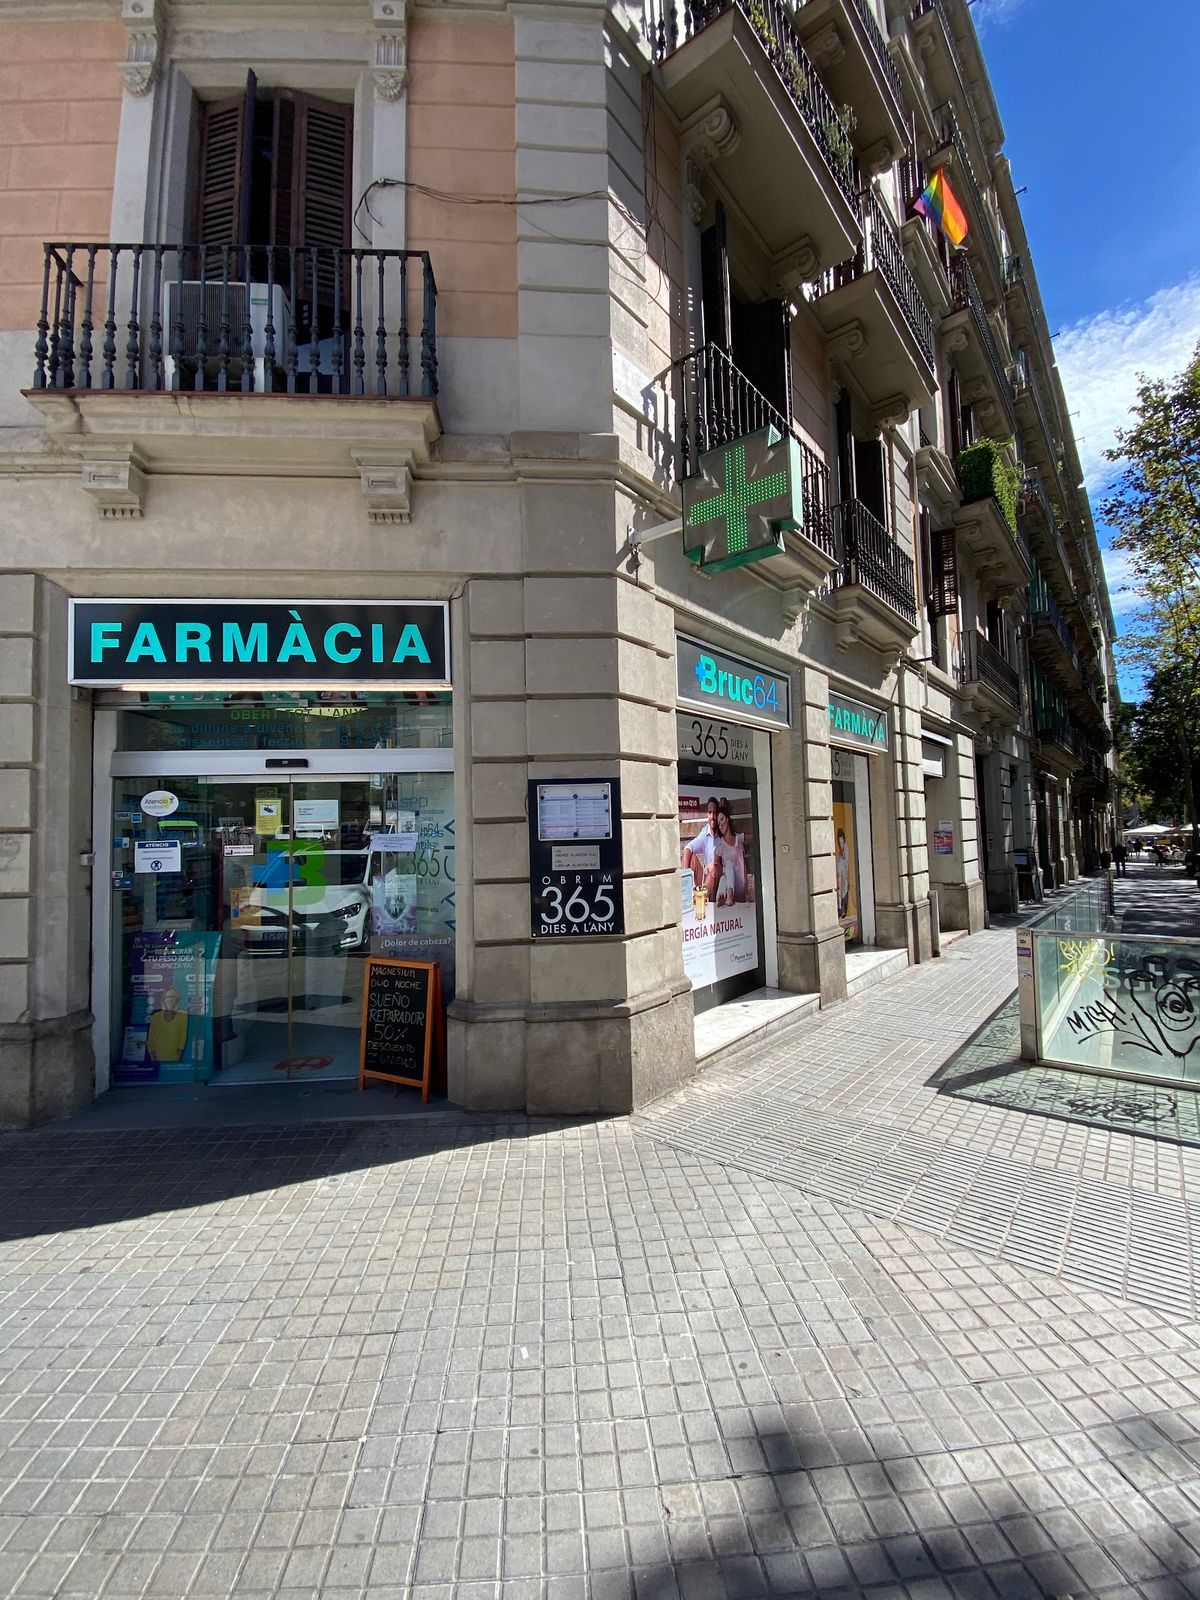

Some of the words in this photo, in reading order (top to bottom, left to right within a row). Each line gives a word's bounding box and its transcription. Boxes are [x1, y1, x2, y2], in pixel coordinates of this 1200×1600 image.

[90, 610, 432, 663] FARMÀCIA
[700, 654, 778, 712] Bruc64
[690, 719, 729, 760] 365
[540, 885, 615, 924] 365
[541, 924, 567, 934] DIES
[571, 923, 579, 933] A
[584, 922, 614, 933] L'ANY
[683, 923, 709, 943] ERGÍA
[709, 917, 743, 937] NATURAL
[380, 938, 406, 949] ¿Dolor
[408, 938, 419, 946] de
[419, 936, 451, 946] cabeza?
[370, 992, 410, 1008] SUEÑO
[369, 1008, 425, 1026] REPARADOR
[374, 1023, 408, 1042] 50%
